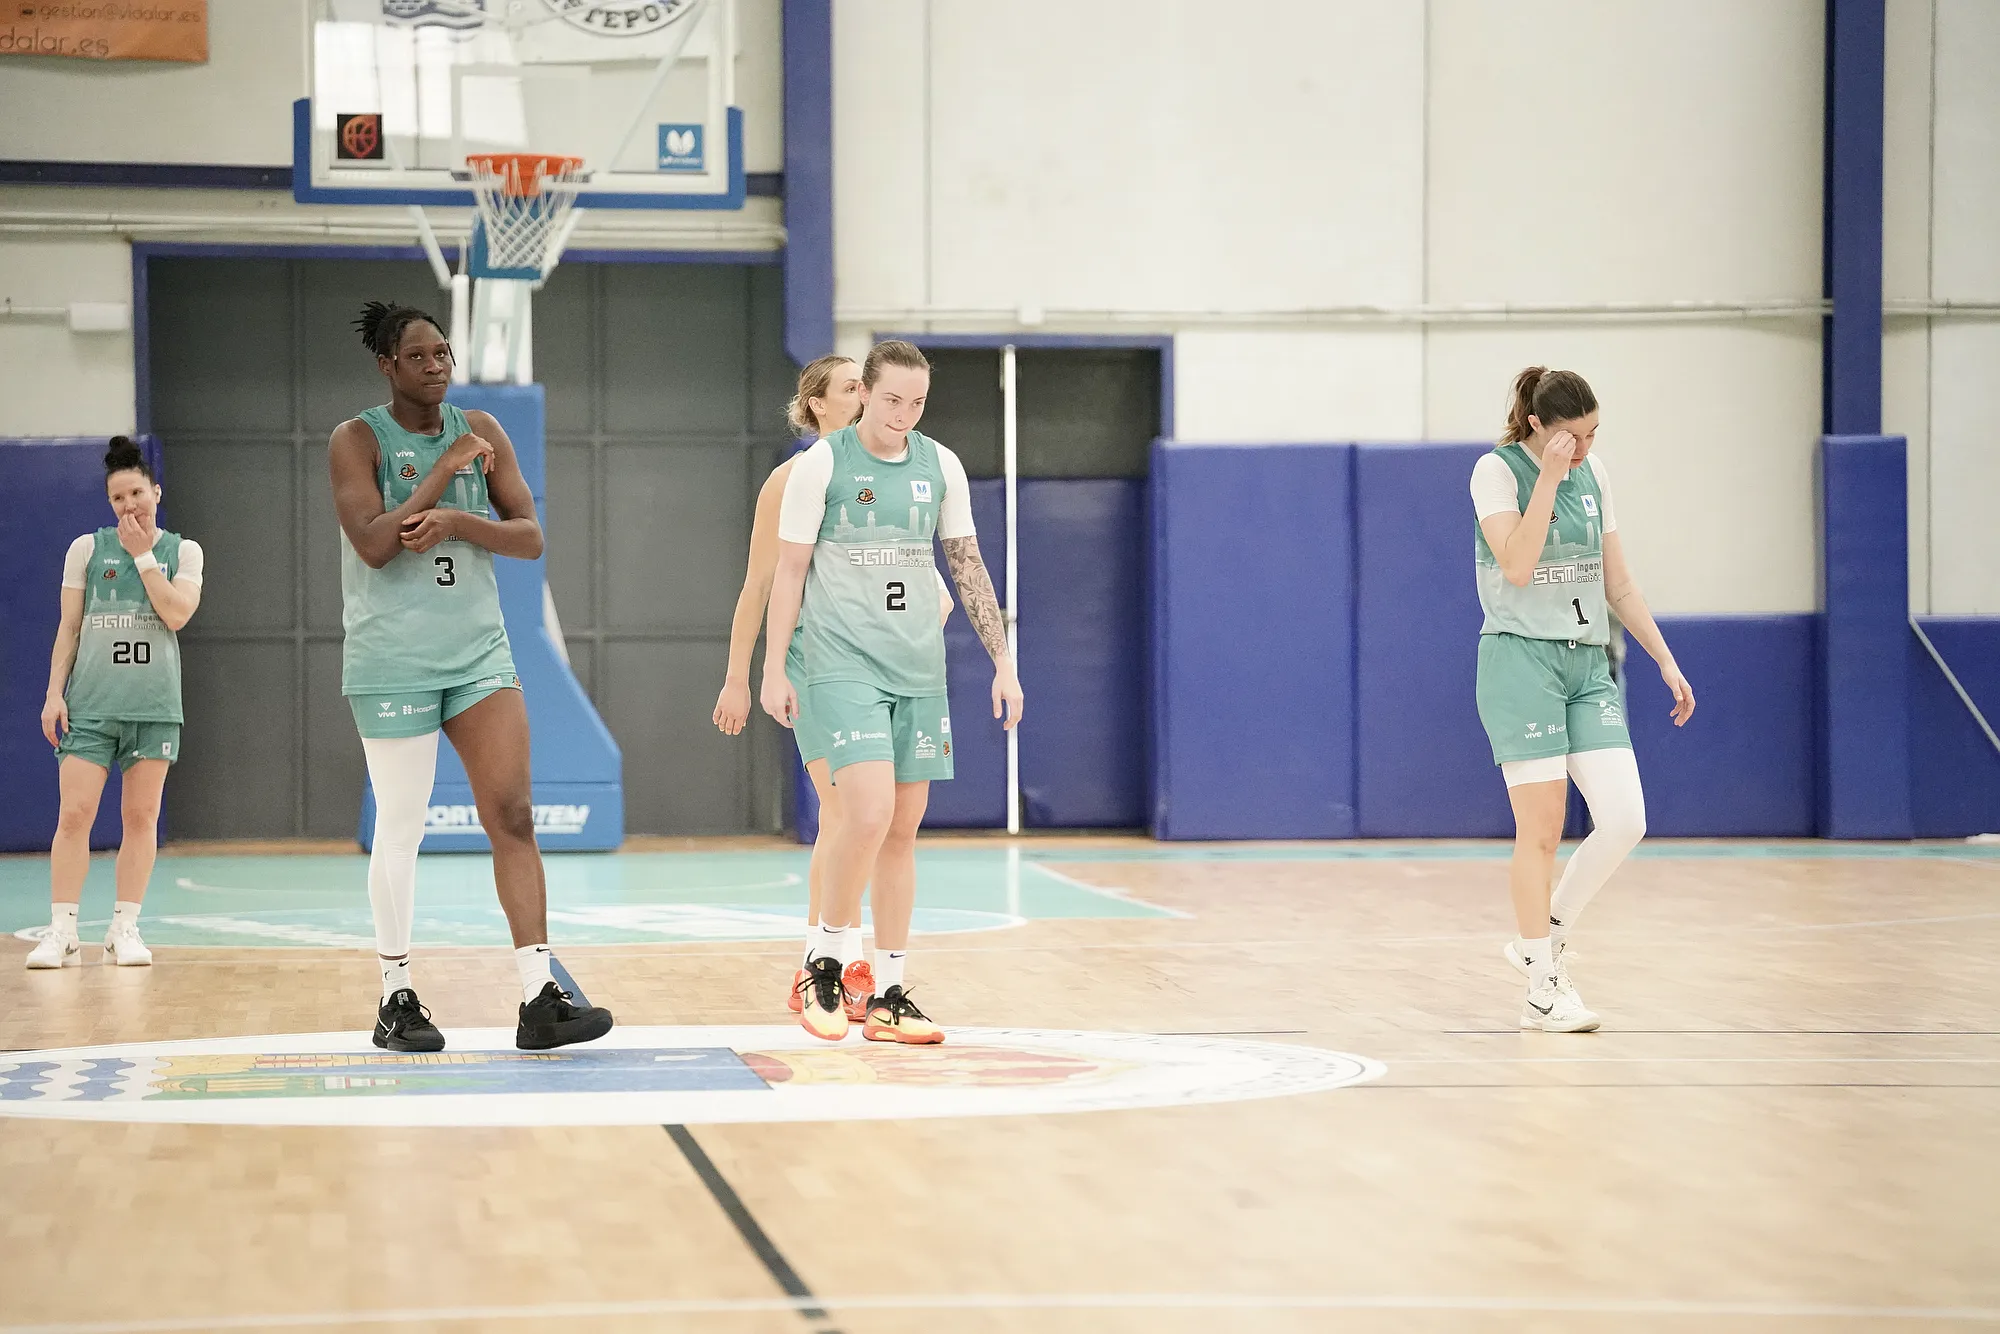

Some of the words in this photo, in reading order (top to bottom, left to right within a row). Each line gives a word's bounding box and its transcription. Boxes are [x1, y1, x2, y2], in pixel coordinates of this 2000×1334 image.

[847, 548, 897, 566] SGM
[434, 556, 456, 587] 3
[1533, 565, 1576, 585] SGM
[886, 581, 907, 612] 2
[91, 614, 133, 630] SGM
[1571, 597, 1590, 626] 1
[112, 641, 151, 665] 20
